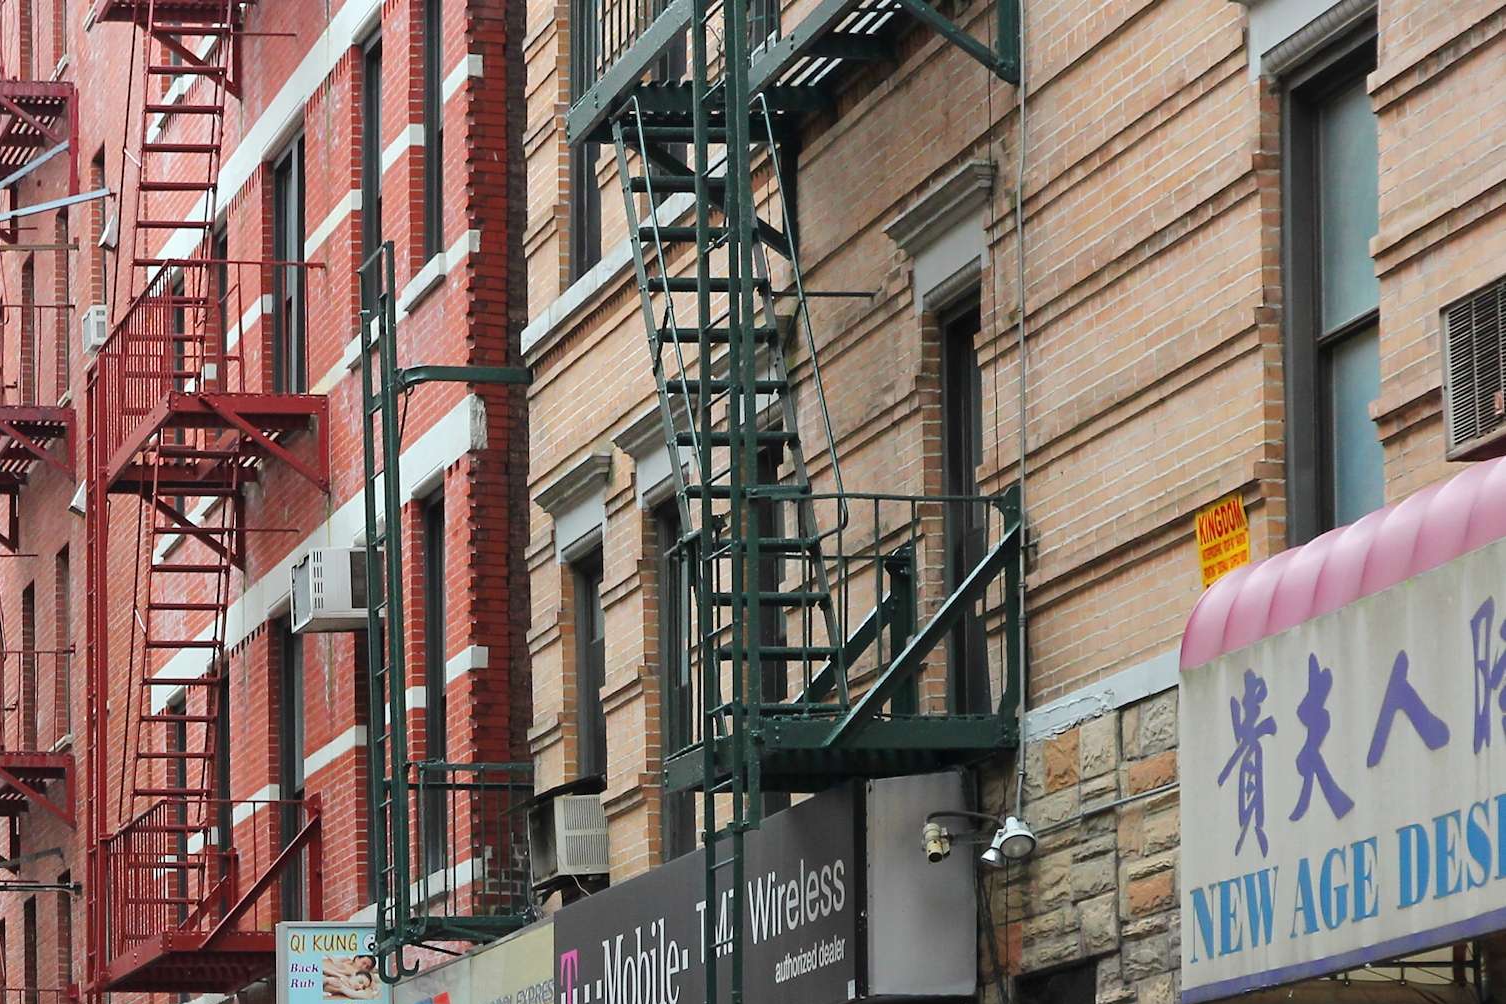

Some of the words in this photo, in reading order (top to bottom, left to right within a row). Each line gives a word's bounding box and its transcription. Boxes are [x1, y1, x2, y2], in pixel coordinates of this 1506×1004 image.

[1197, 497, 1246, 545] KINGDOM
[748, 858, 846, 945] Wireless
[1190, 866, 1279, 964] NEW
[1290, 836, 1380, 939] AGE
[290, 934, 305, 953] QI
[313, 933, 358, 952] KUNG
[775, 942, 818, 984] authorized
[818, 934, 846, 968] dealer
[290, 963, 319, 973] Back
[290, 979, 315, 988] Rub
